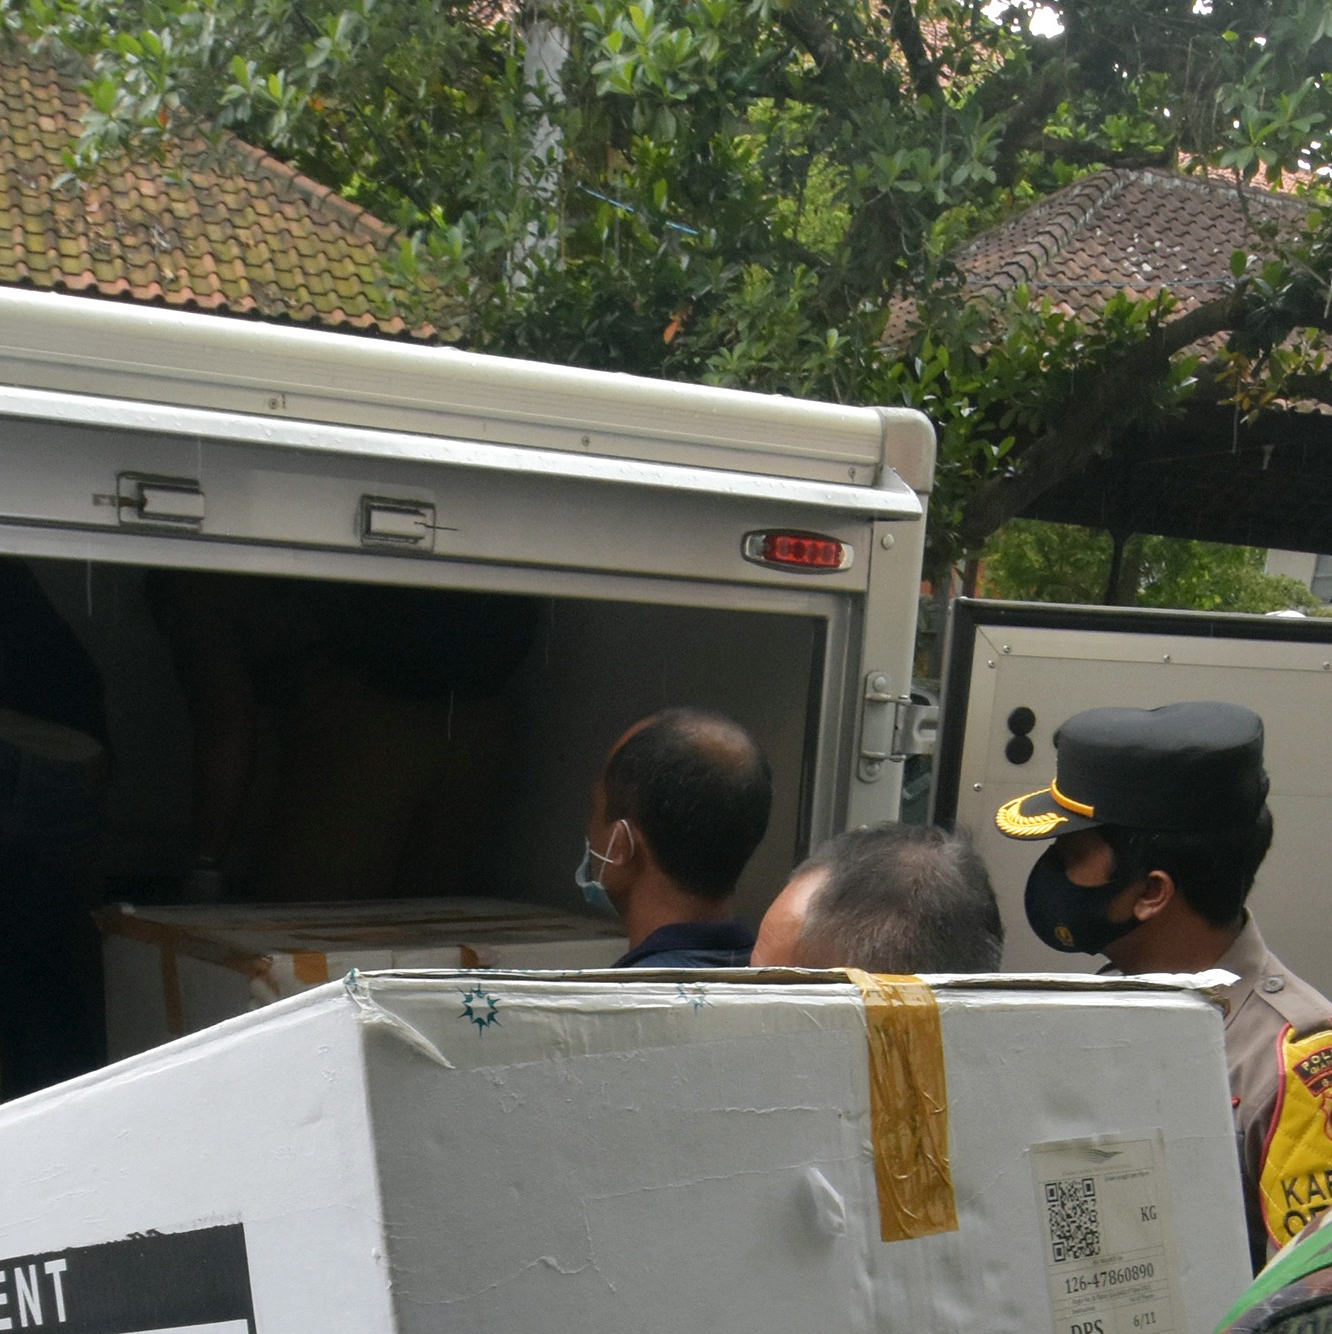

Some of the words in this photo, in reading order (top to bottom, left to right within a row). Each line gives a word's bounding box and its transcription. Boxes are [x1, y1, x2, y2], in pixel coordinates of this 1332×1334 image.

[1140, 1204, 1158, 1222] KG
[1065, 1262, 1154, 1295] 126-47860890
[1133, 1311, 1157, 1330] 6/11
